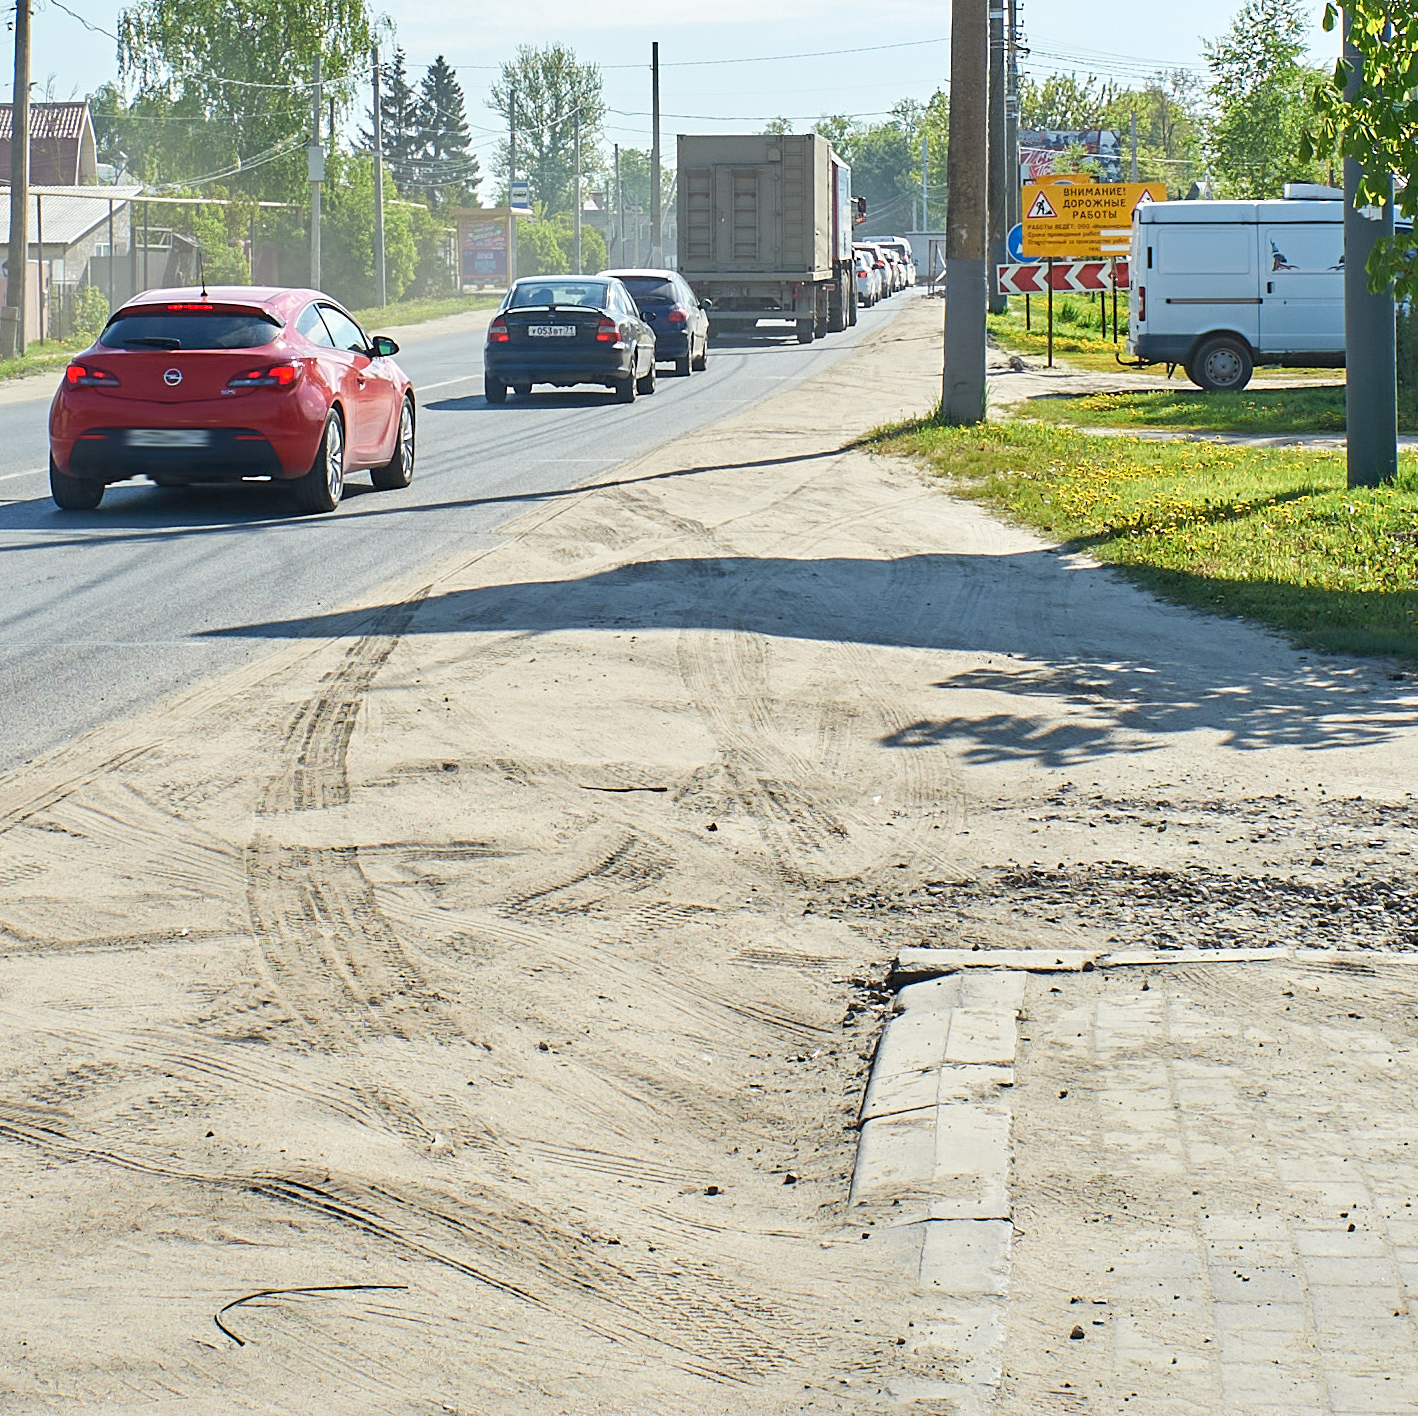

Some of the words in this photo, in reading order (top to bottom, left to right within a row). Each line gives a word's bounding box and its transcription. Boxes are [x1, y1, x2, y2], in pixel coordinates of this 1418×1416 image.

[1063, 187, 1126, 197] ВНИМАНИЕ!
[1062, 198, 1126, 209] ДОРОЖНЫЕ
[1072, 210, 1117, 219] РАБОТЫ
